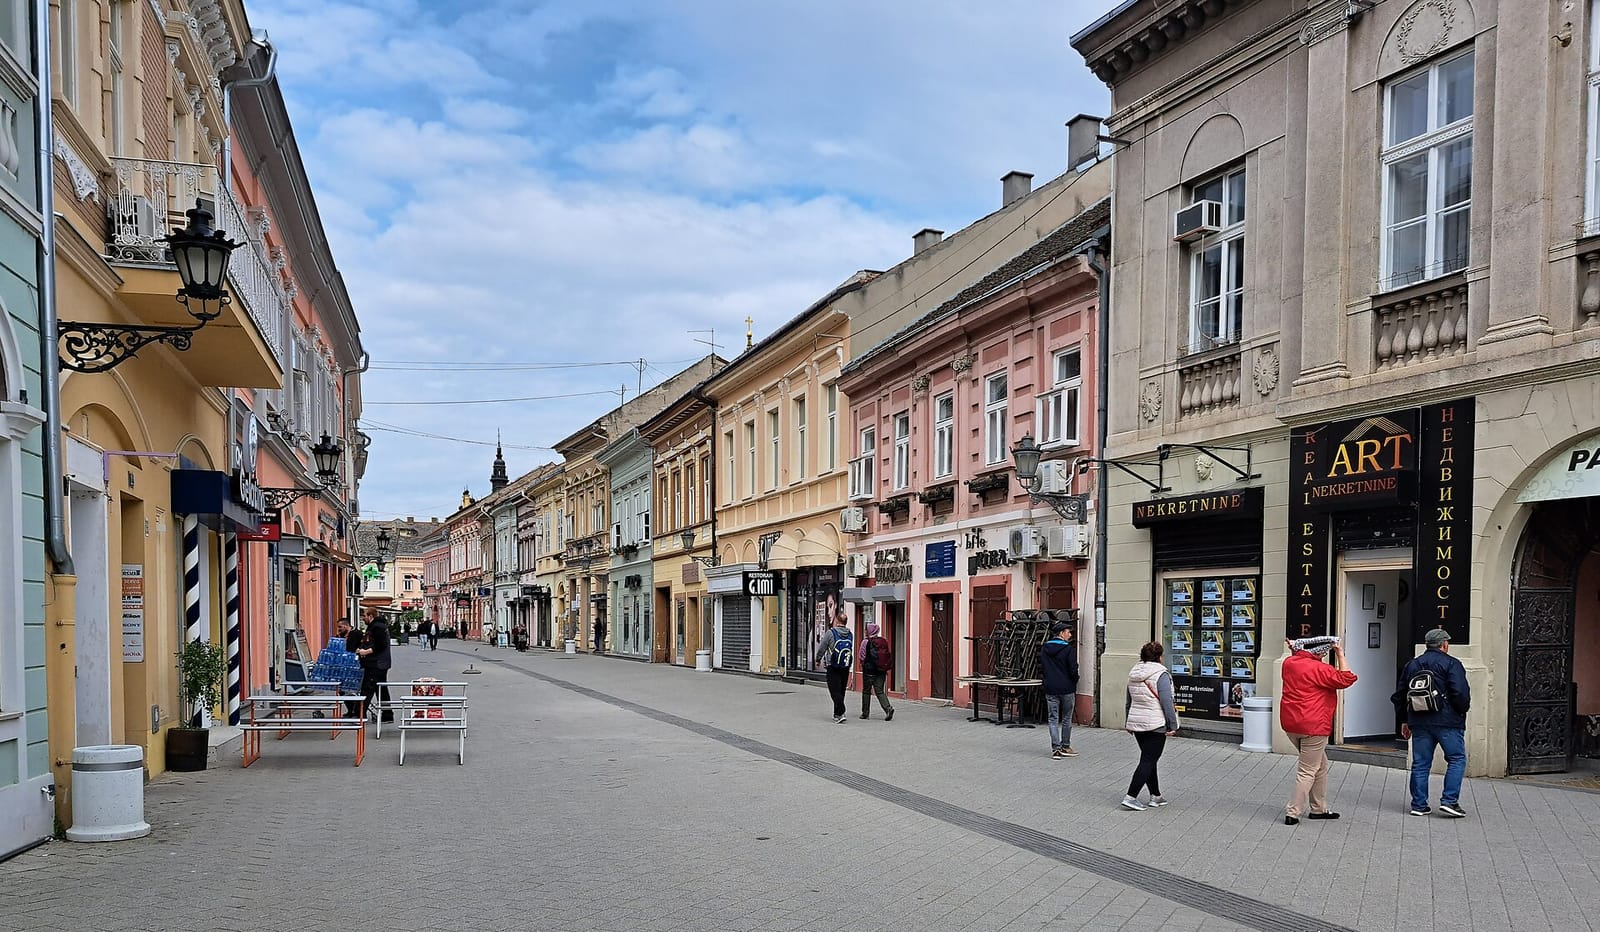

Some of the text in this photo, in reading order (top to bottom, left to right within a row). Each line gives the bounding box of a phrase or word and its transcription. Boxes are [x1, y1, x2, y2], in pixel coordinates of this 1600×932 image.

[1327, 433, 1412, 478] ART
[1136, 494, 1241, 519] NEKRETNINE
[1312, 477, 1397, 498] NEKRETNINE
[1300, 431, 1317, 637] REAL ESTATE
[1436, 407, 1455, 630] НЕДВИЖИМОСТ
